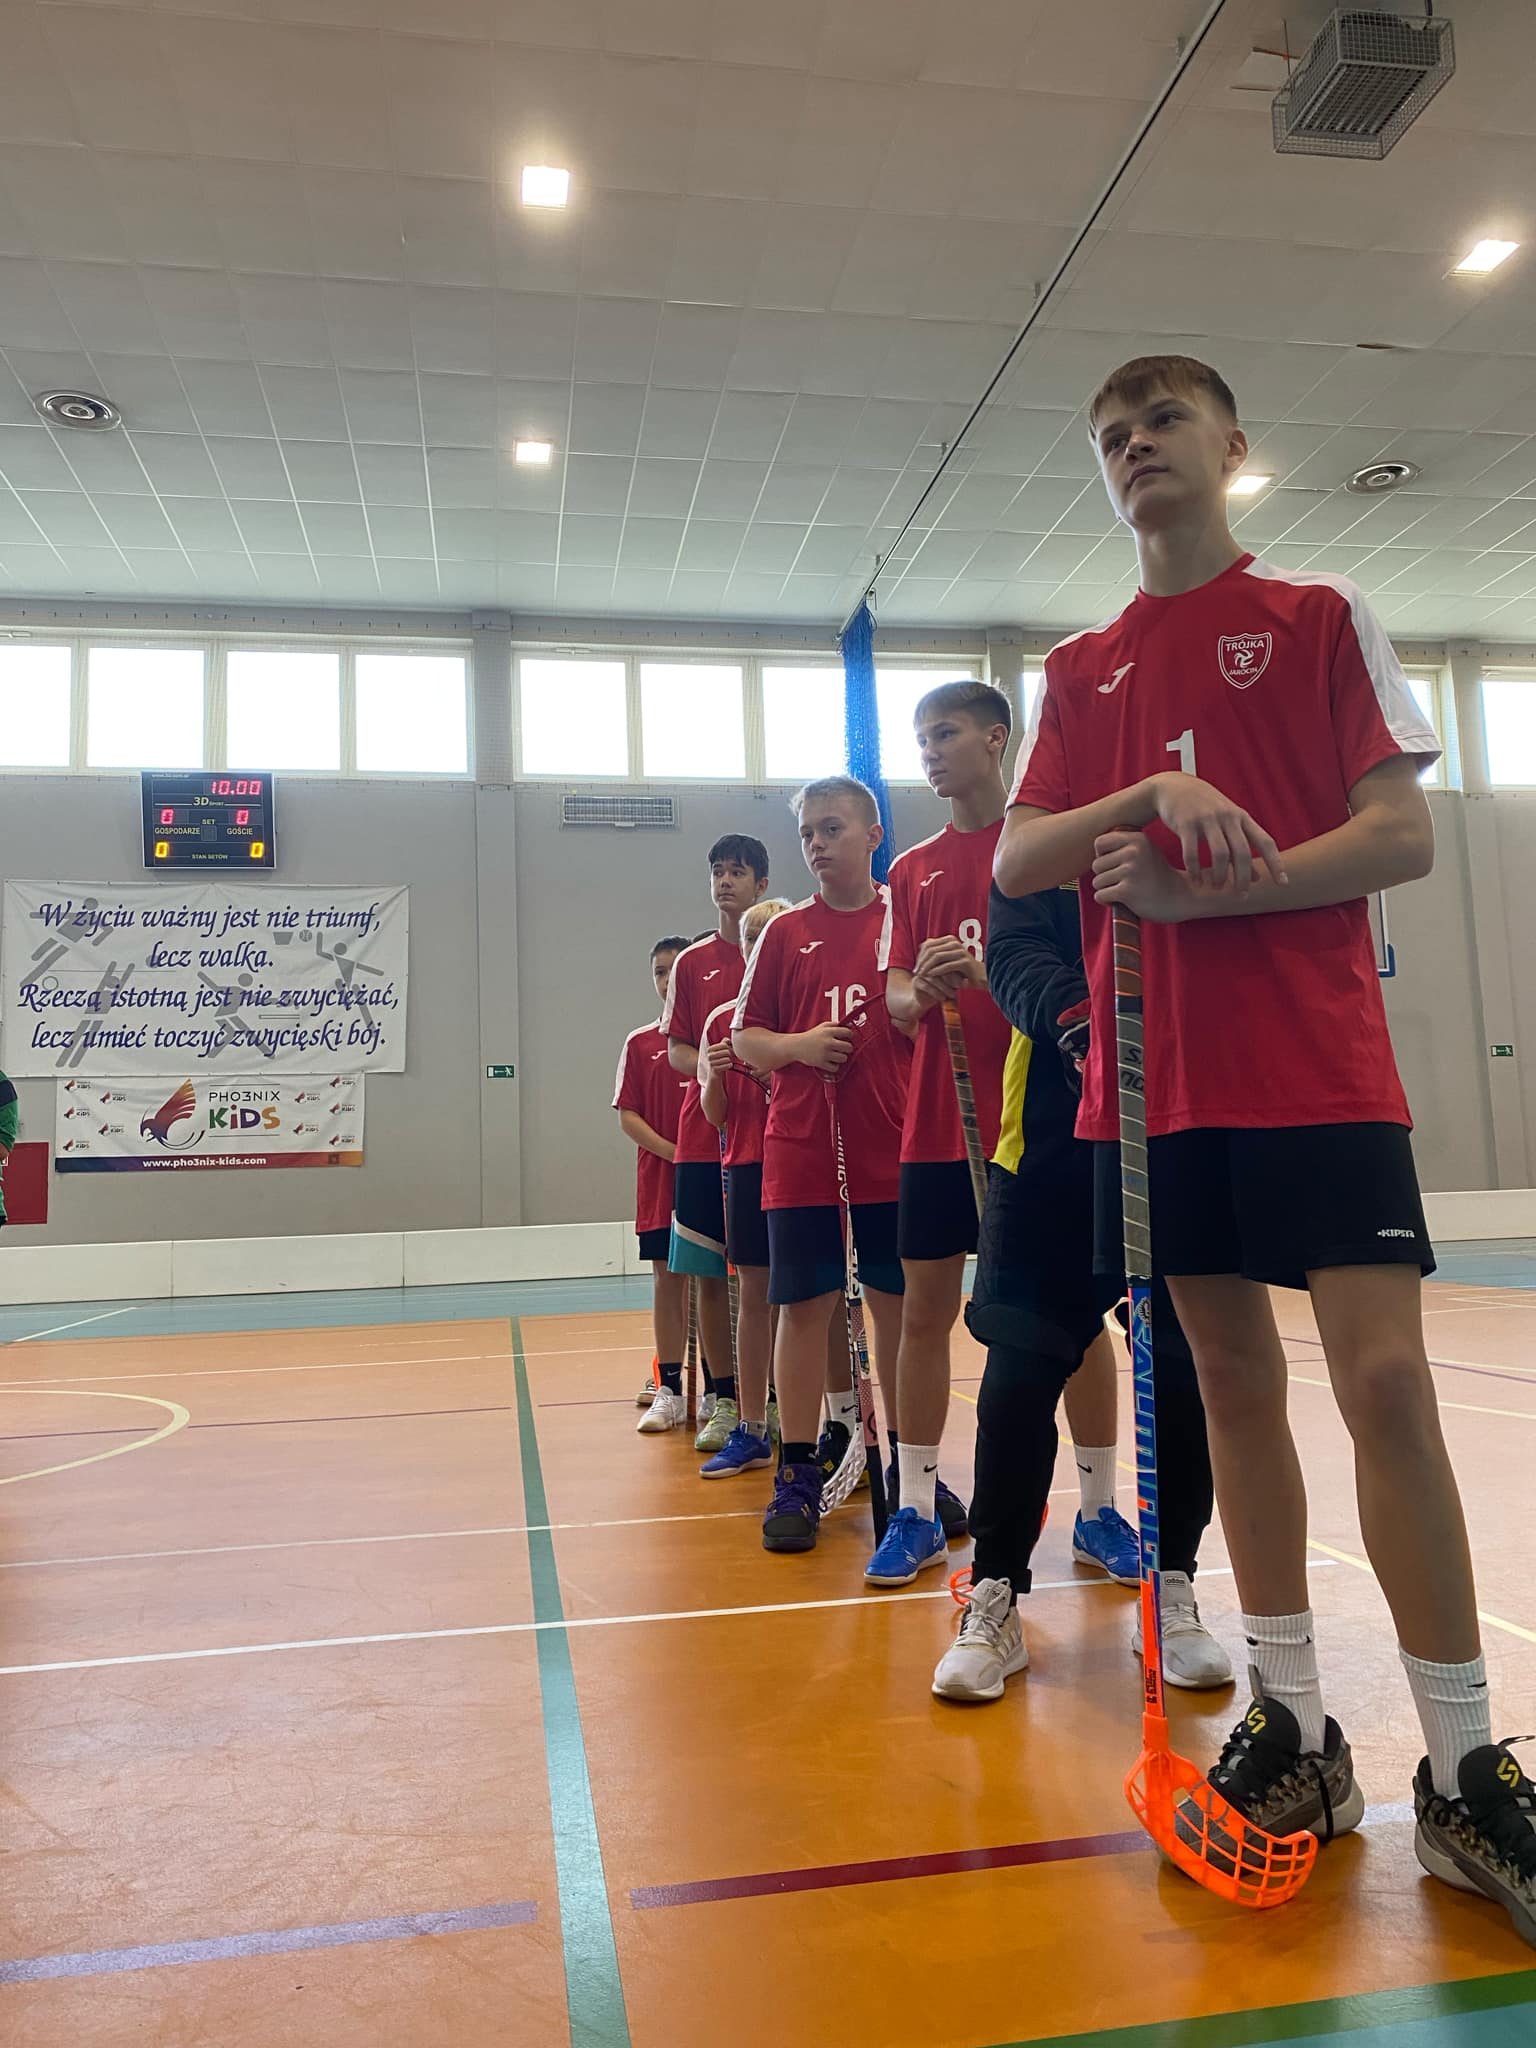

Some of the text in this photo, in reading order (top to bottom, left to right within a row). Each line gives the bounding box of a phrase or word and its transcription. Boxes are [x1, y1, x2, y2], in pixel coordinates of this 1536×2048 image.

[1166, 729, 1197, 777] 1
[211, 780, 262, 795] 10.00
[193, 796, 209, 806] 3D
[155, 827, 200, 835] GOSPODARZE
[227, 827, 254, 835] GOŚCIE
[155, 842, 169, 857] 0
[250, 842, 264, 857] 0
[39, 900, 381, 938] W życiu ważny jest nie triumf,
[958, 918, 984, 963] 8
[149, 940, 274, 973] lecz walka.
[17, 982, 399, 1018] Rzeczą istotną jest nie zwyciężać,
[824, 983, 868, 1028] 16
[31, 1019, 386, 1058] lecz umieć toczyć zwycięski bój.
[209, 1090, 280, 1102] PHO3NIX
[142, 1156, 267, 1168] www.pho3nix-kids.com
